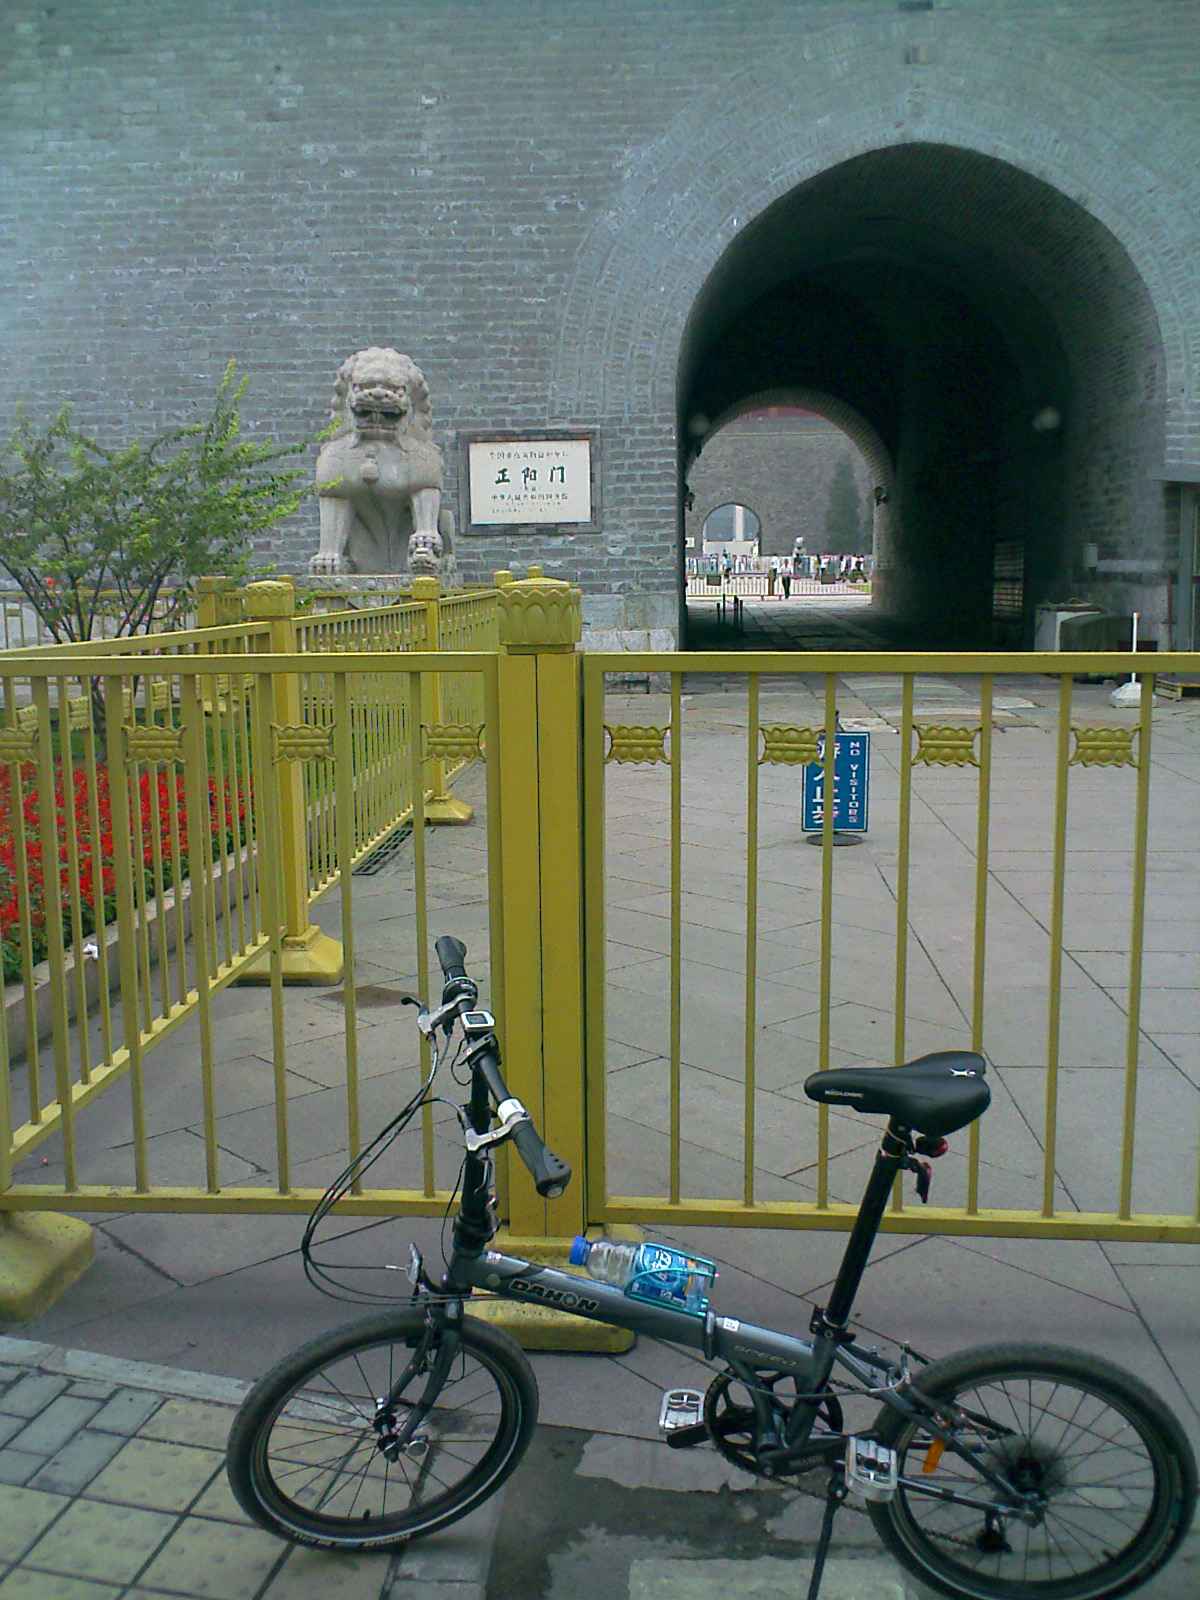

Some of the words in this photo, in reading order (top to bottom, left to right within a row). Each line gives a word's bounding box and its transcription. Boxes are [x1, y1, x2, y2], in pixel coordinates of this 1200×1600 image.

[494, 465, 566, 490] 正阳门
[849, 741, 860, 756] NO
[848, 763, 860, 823] VISITORS
[508, 1278, 600, 1312] DAHON
